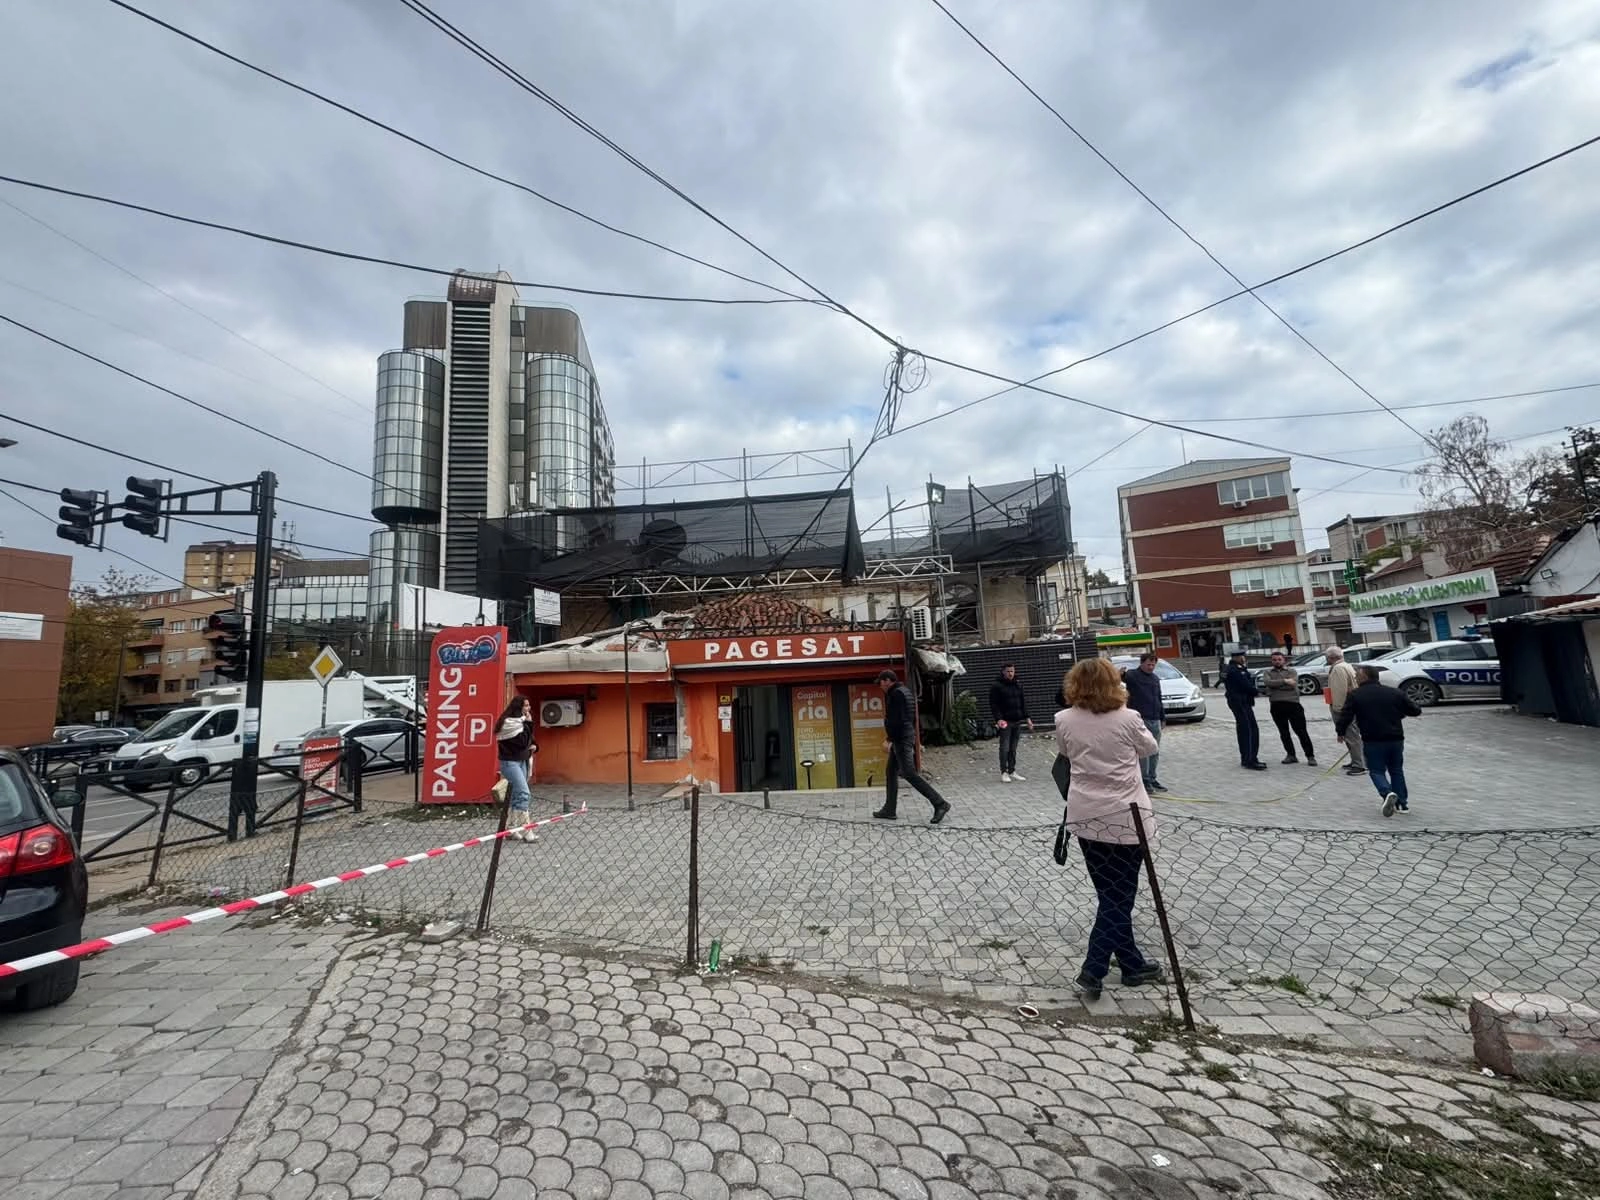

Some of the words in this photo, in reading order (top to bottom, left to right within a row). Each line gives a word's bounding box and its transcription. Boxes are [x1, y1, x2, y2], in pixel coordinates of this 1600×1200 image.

[704, 636, 864, 660] PAGESAT
[798, 700, 828, 720] ria
[853, 692, 882, 712] ria
[432, 667, 462, 797] PARKING
[470, 718, 487, 742] P
